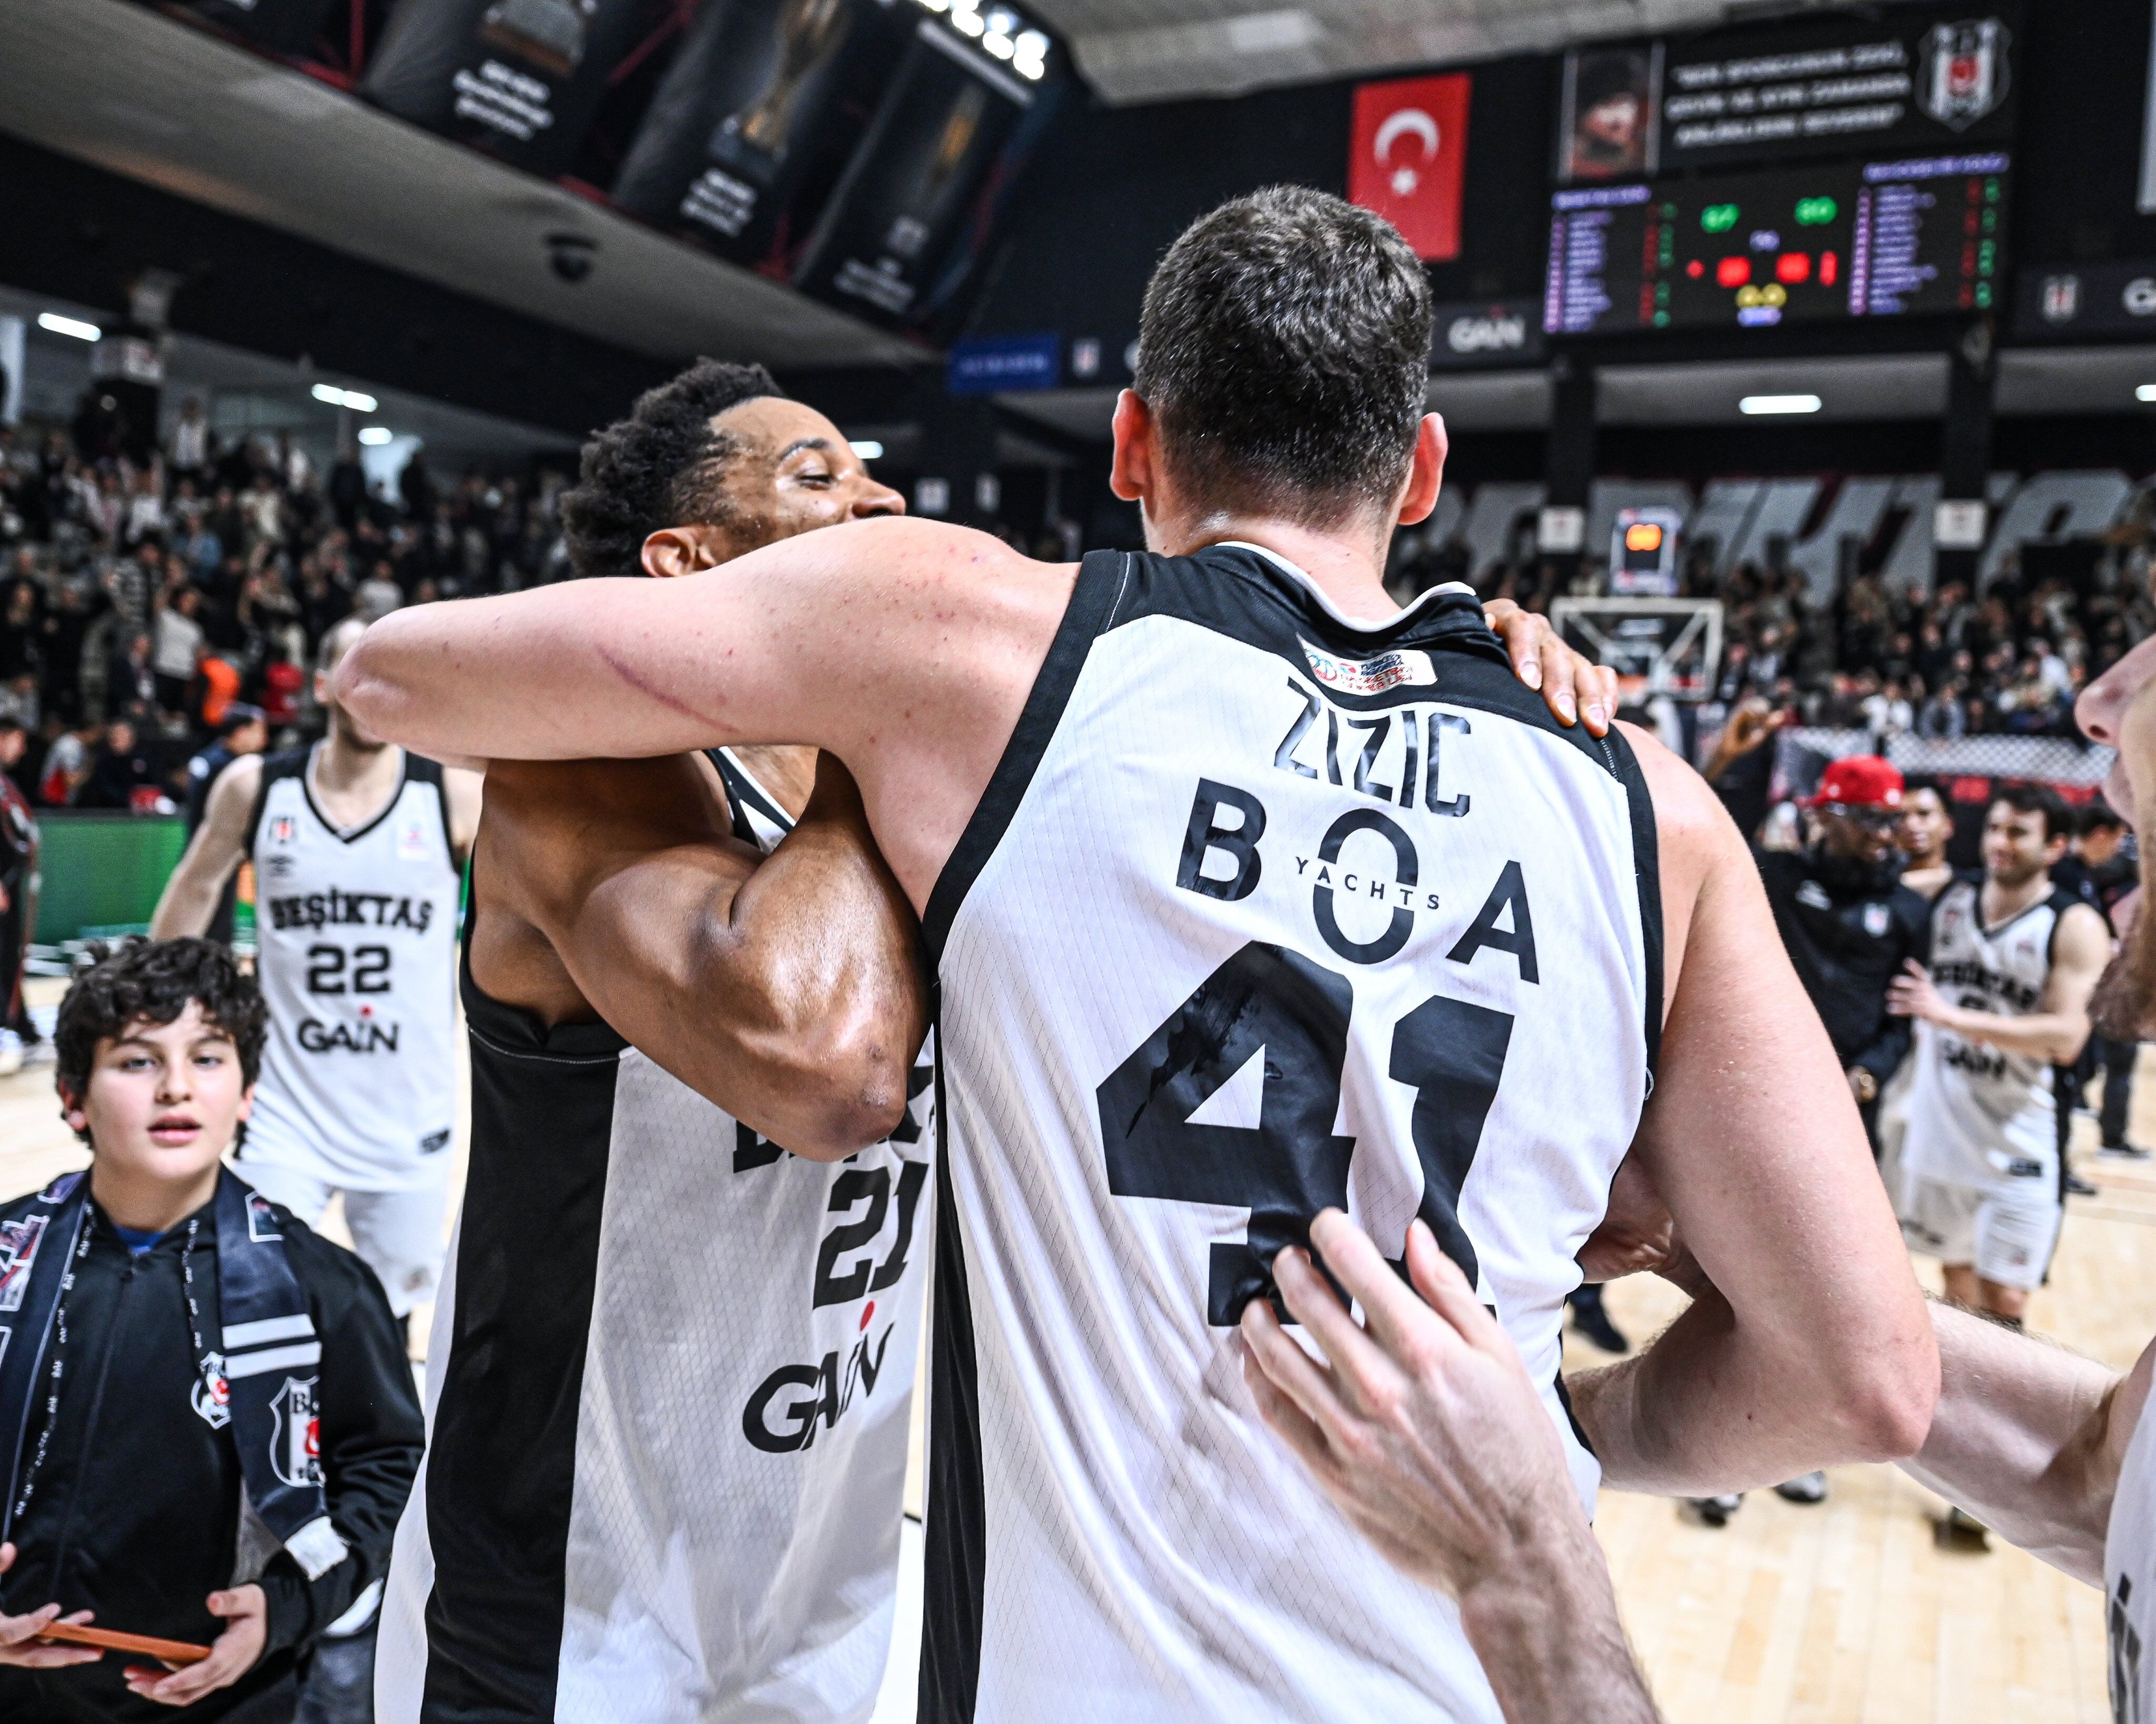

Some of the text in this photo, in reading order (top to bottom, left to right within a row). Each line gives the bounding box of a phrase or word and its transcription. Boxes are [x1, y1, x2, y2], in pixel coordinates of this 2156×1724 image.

[1274, 676, 1471, 817] ZIZIC
[1295, 856, 1439, 910] YACHTS
[305, 944, 392, 996] 22
[1096, 939, 1515, 1326] 41
[813, 1160, 929, 1310] 21
